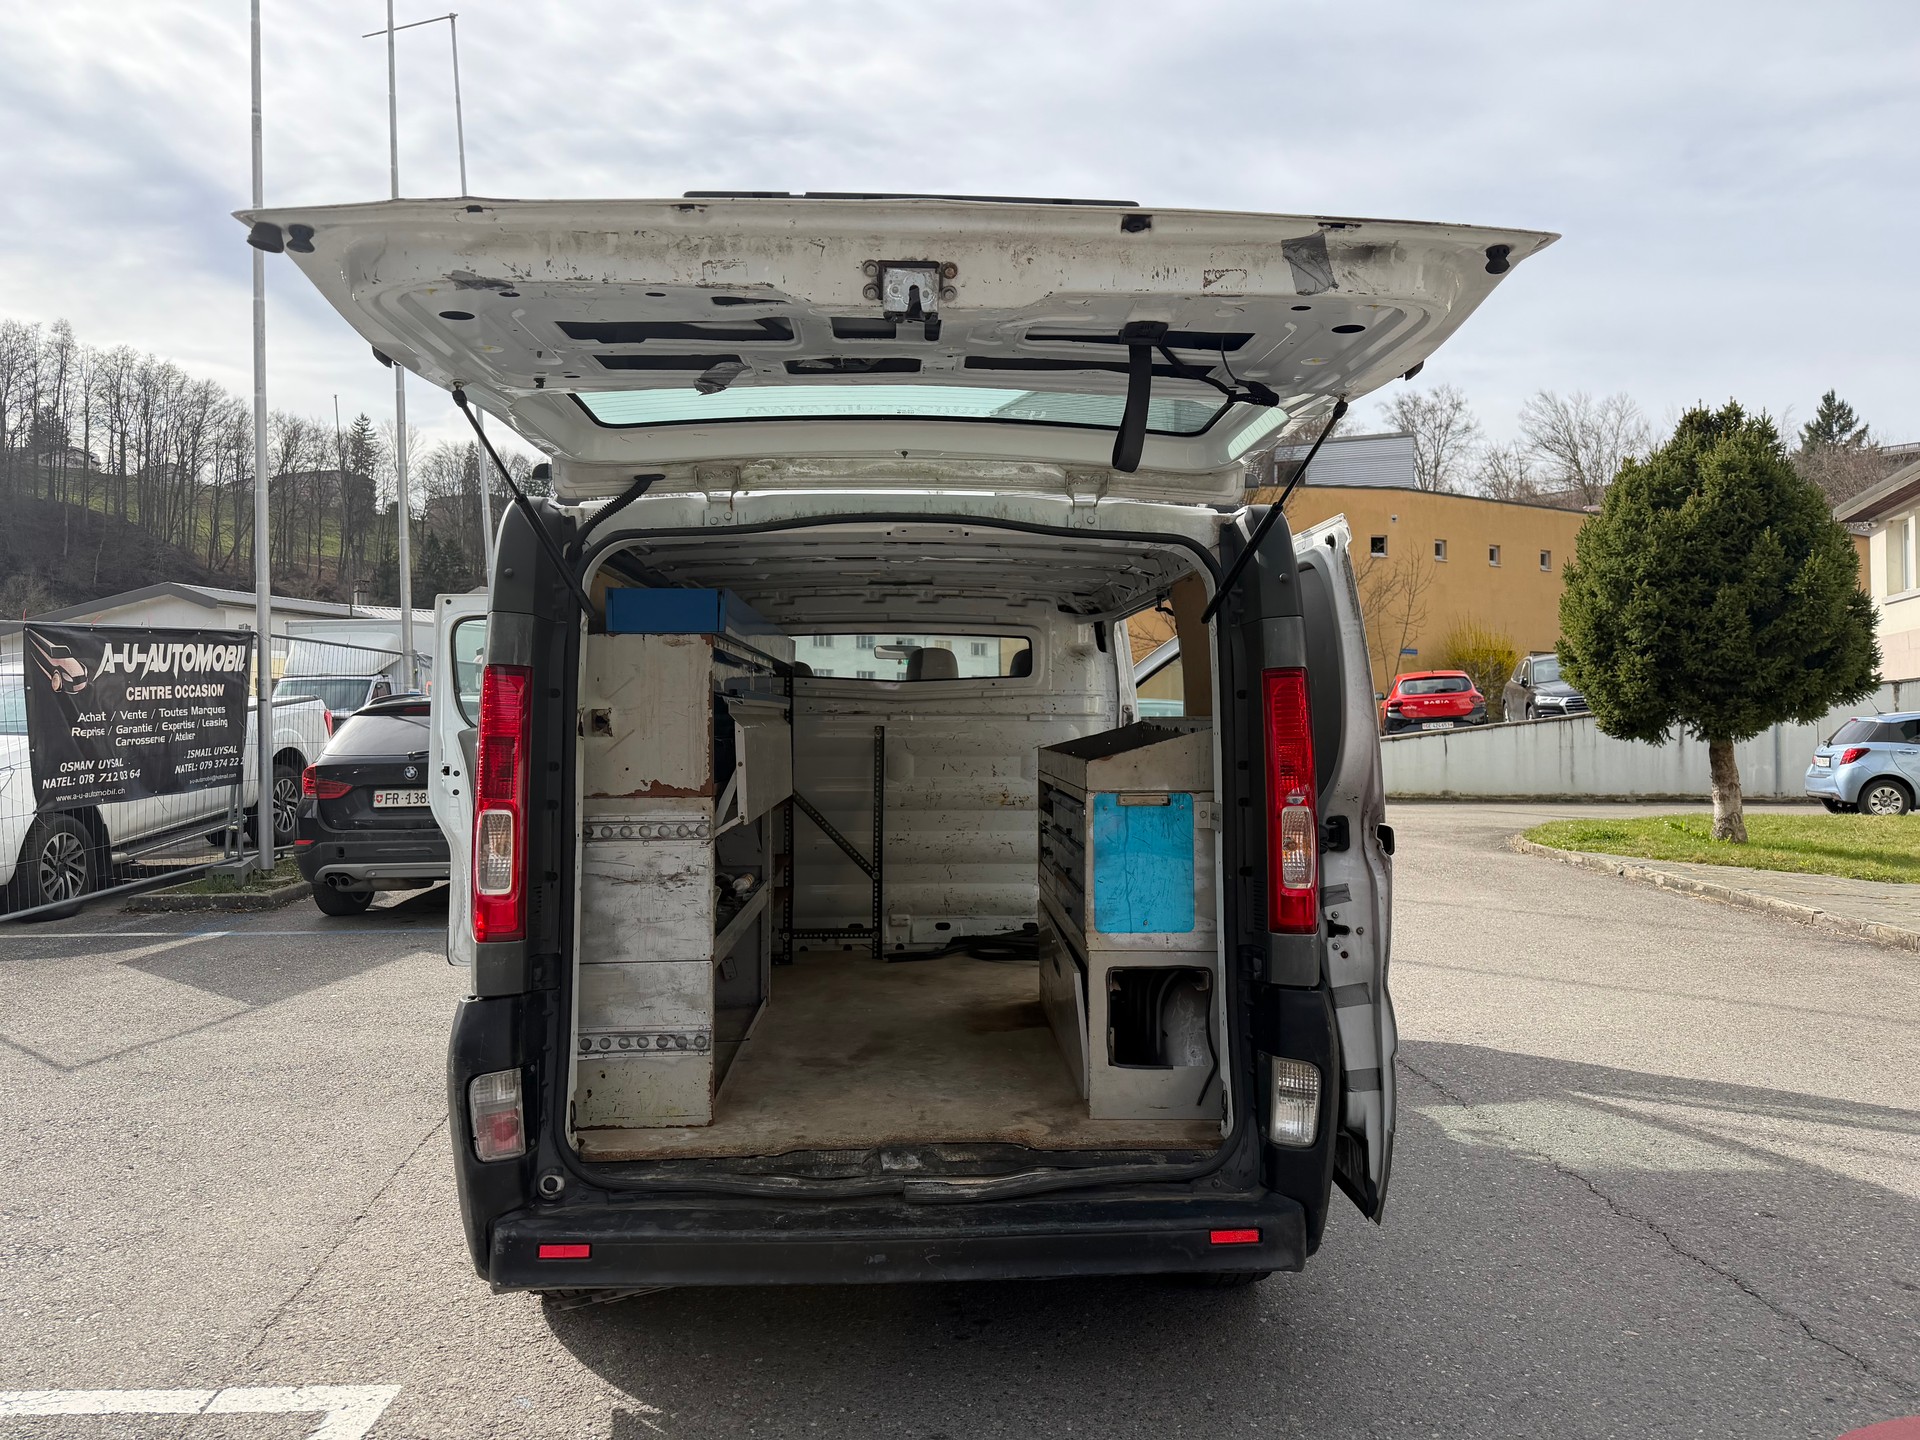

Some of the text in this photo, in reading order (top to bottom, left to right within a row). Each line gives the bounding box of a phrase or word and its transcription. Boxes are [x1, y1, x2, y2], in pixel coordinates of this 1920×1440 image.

[126, 684, 225, 701] CENTRE OCCASION
[77, 711, 107, 723] Achat
[120, 709, 147, 720] Vente
[159, 707, 188, 718] Toutes
[191, 706, 226, 717] Marques
[71, 726, 106, 739] Reprise
[115, 723, 153, 735] Garantie
[162, 720, 195, 732] Expertise
[202, 717, 228, 728] Leasing
[115, 734, 166, 747] Carrosserie
[175, 732, 196, 742] Atelier
[186, 745, 238, 759] ISMAIL UYSAL
[98, 757, 124, 770] UYSAL
[174, 762, 198, 775] NATEL:
[199, 759, 213, 771] 079
[214, 758, 228, 769] 374
[229, 757, 240, 767] 22
[42, 768, 141, 790] NATEL: 078 712 03 64
[55, 787, 126, 802] www.a-u-automobil.ch
[384, 792, 431, 805] FR 138
